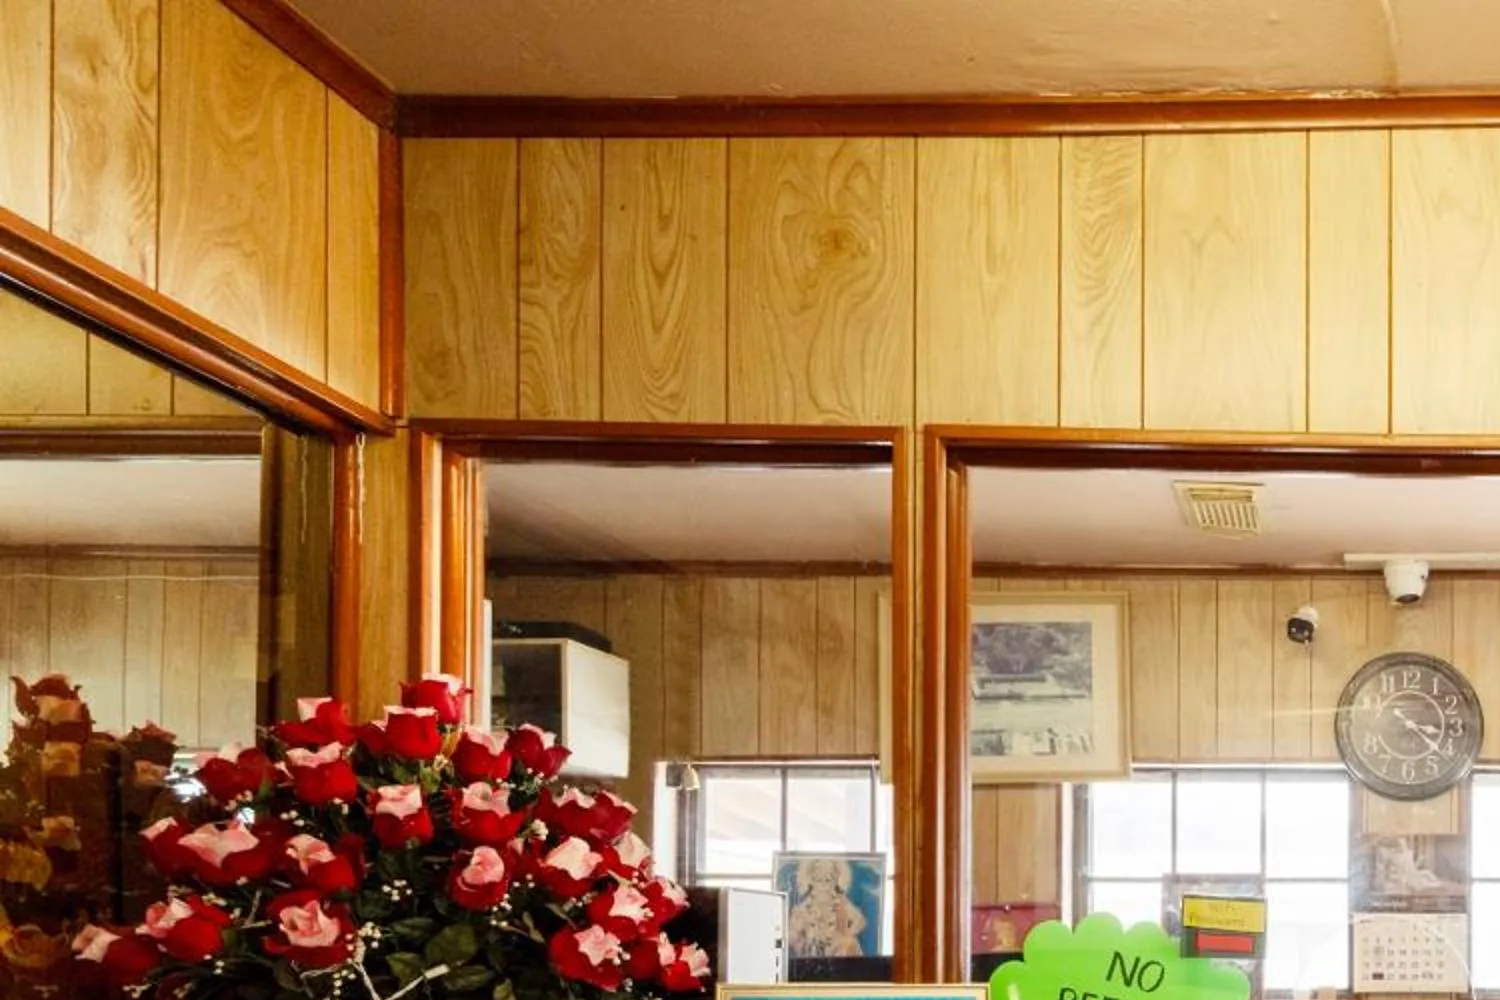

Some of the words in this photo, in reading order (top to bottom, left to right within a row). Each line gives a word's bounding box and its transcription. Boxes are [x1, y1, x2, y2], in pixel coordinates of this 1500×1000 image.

[1381, 671, 1396, 693] 11
[1402, 669, 1421, 689] 12
[1432, 677, 1439, 695] 1
[1445, 695, 1458, 715] 2
[1449, 716, 1463, 737] 3
[1363, 734, 1378, 754] 8
[1443, 738, 1456, 755] 4
[1379, 755, 1392, 774] 7
[1402, 760, 1415, 781] 6
[1425, 755, 1439, 775] 5
[1105, 950, 1166, 993] NO
